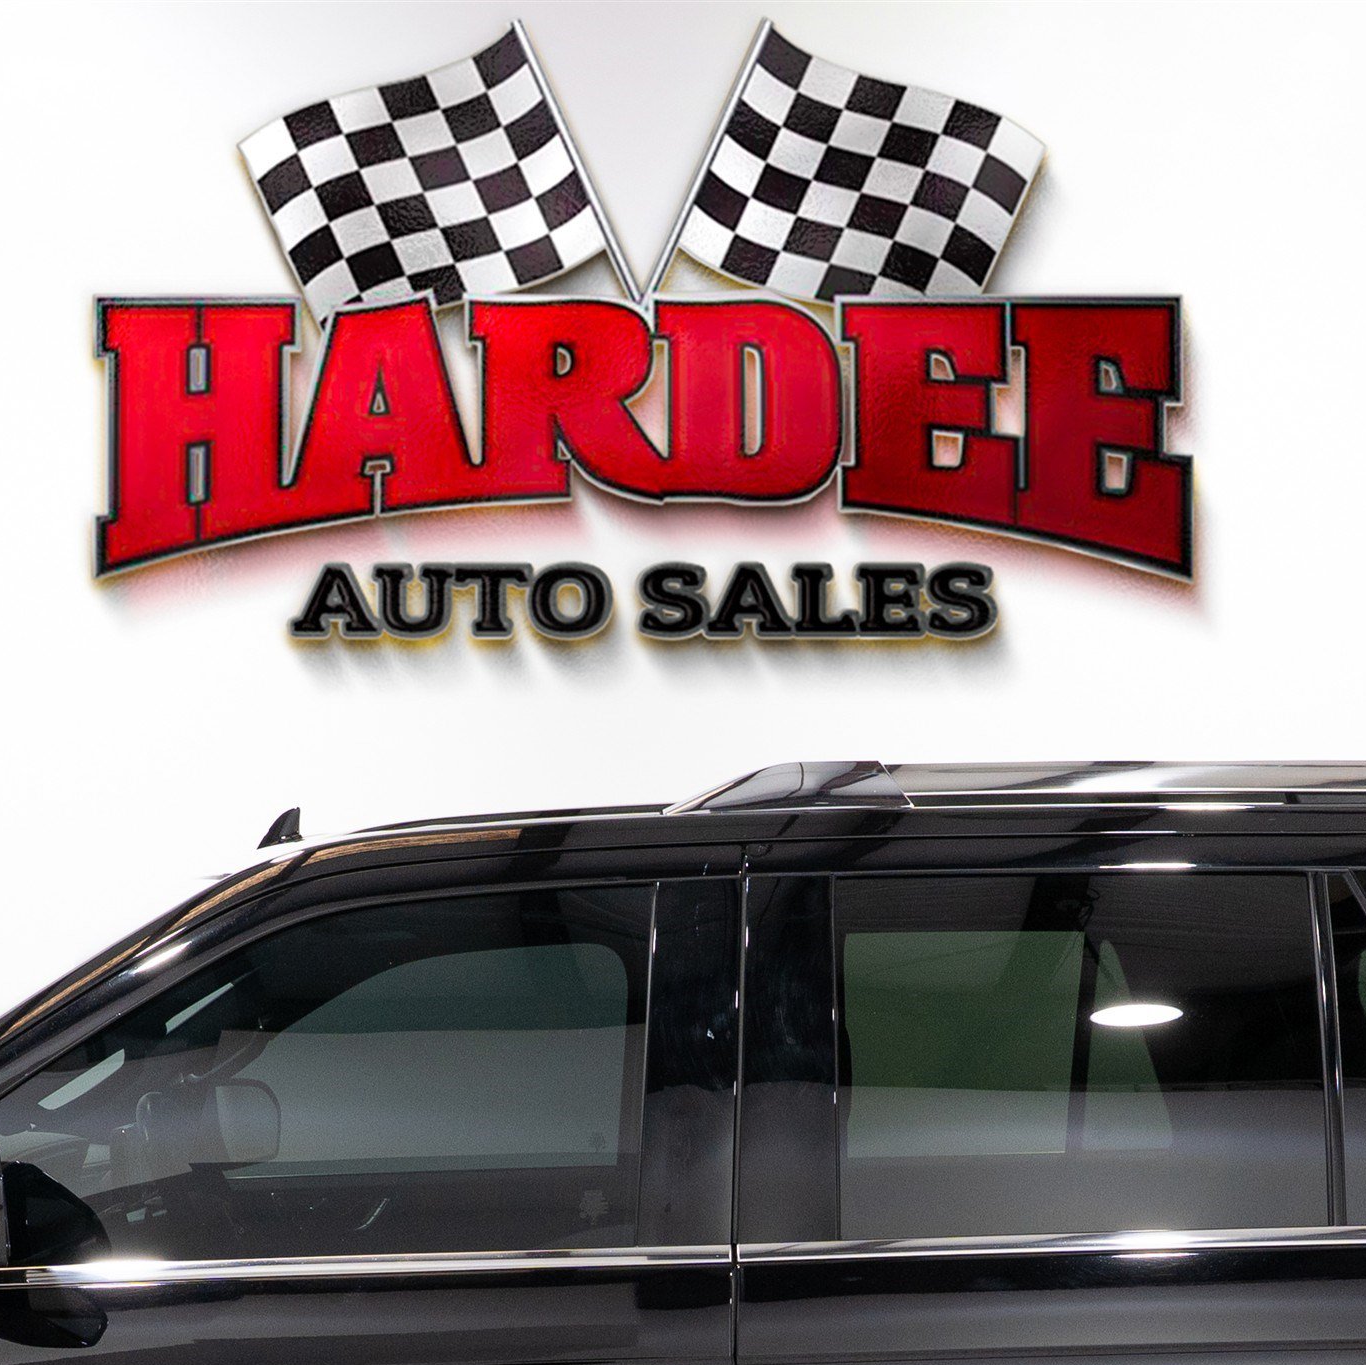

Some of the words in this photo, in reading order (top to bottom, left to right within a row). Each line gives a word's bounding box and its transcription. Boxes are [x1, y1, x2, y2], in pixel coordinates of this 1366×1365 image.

[94, 295, 1193, 582] HARDEE
[289, 562, 609, 641] AUTO
[635, 562, 999, 641] SALES
